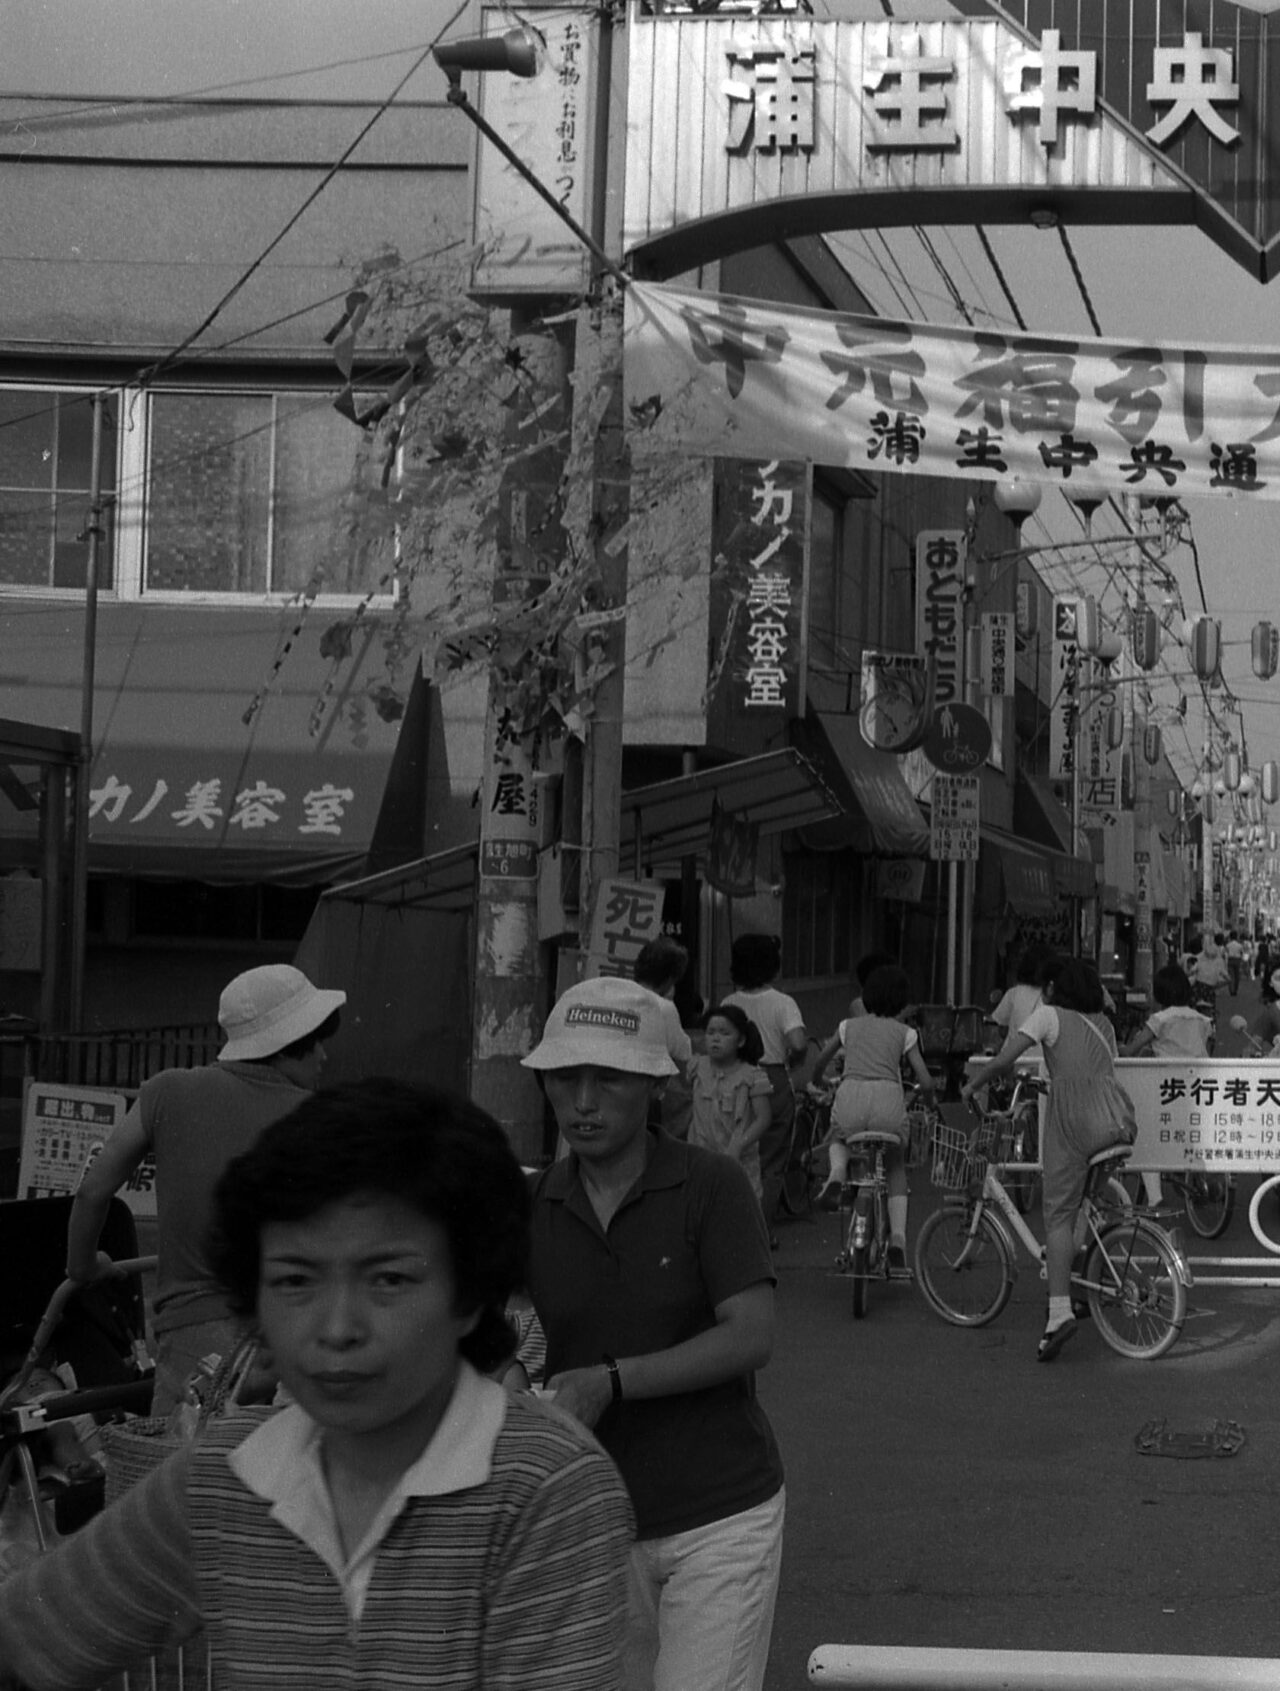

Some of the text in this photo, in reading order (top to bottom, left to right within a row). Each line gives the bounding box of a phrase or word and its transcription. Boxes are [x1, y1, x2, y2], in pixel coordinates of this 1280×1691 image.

[89, 774, 354, 835] カノ美容室
[568, 1008, 637, 1029] Heineken
[1160, 1130, 1201, 1143] 日祝日
